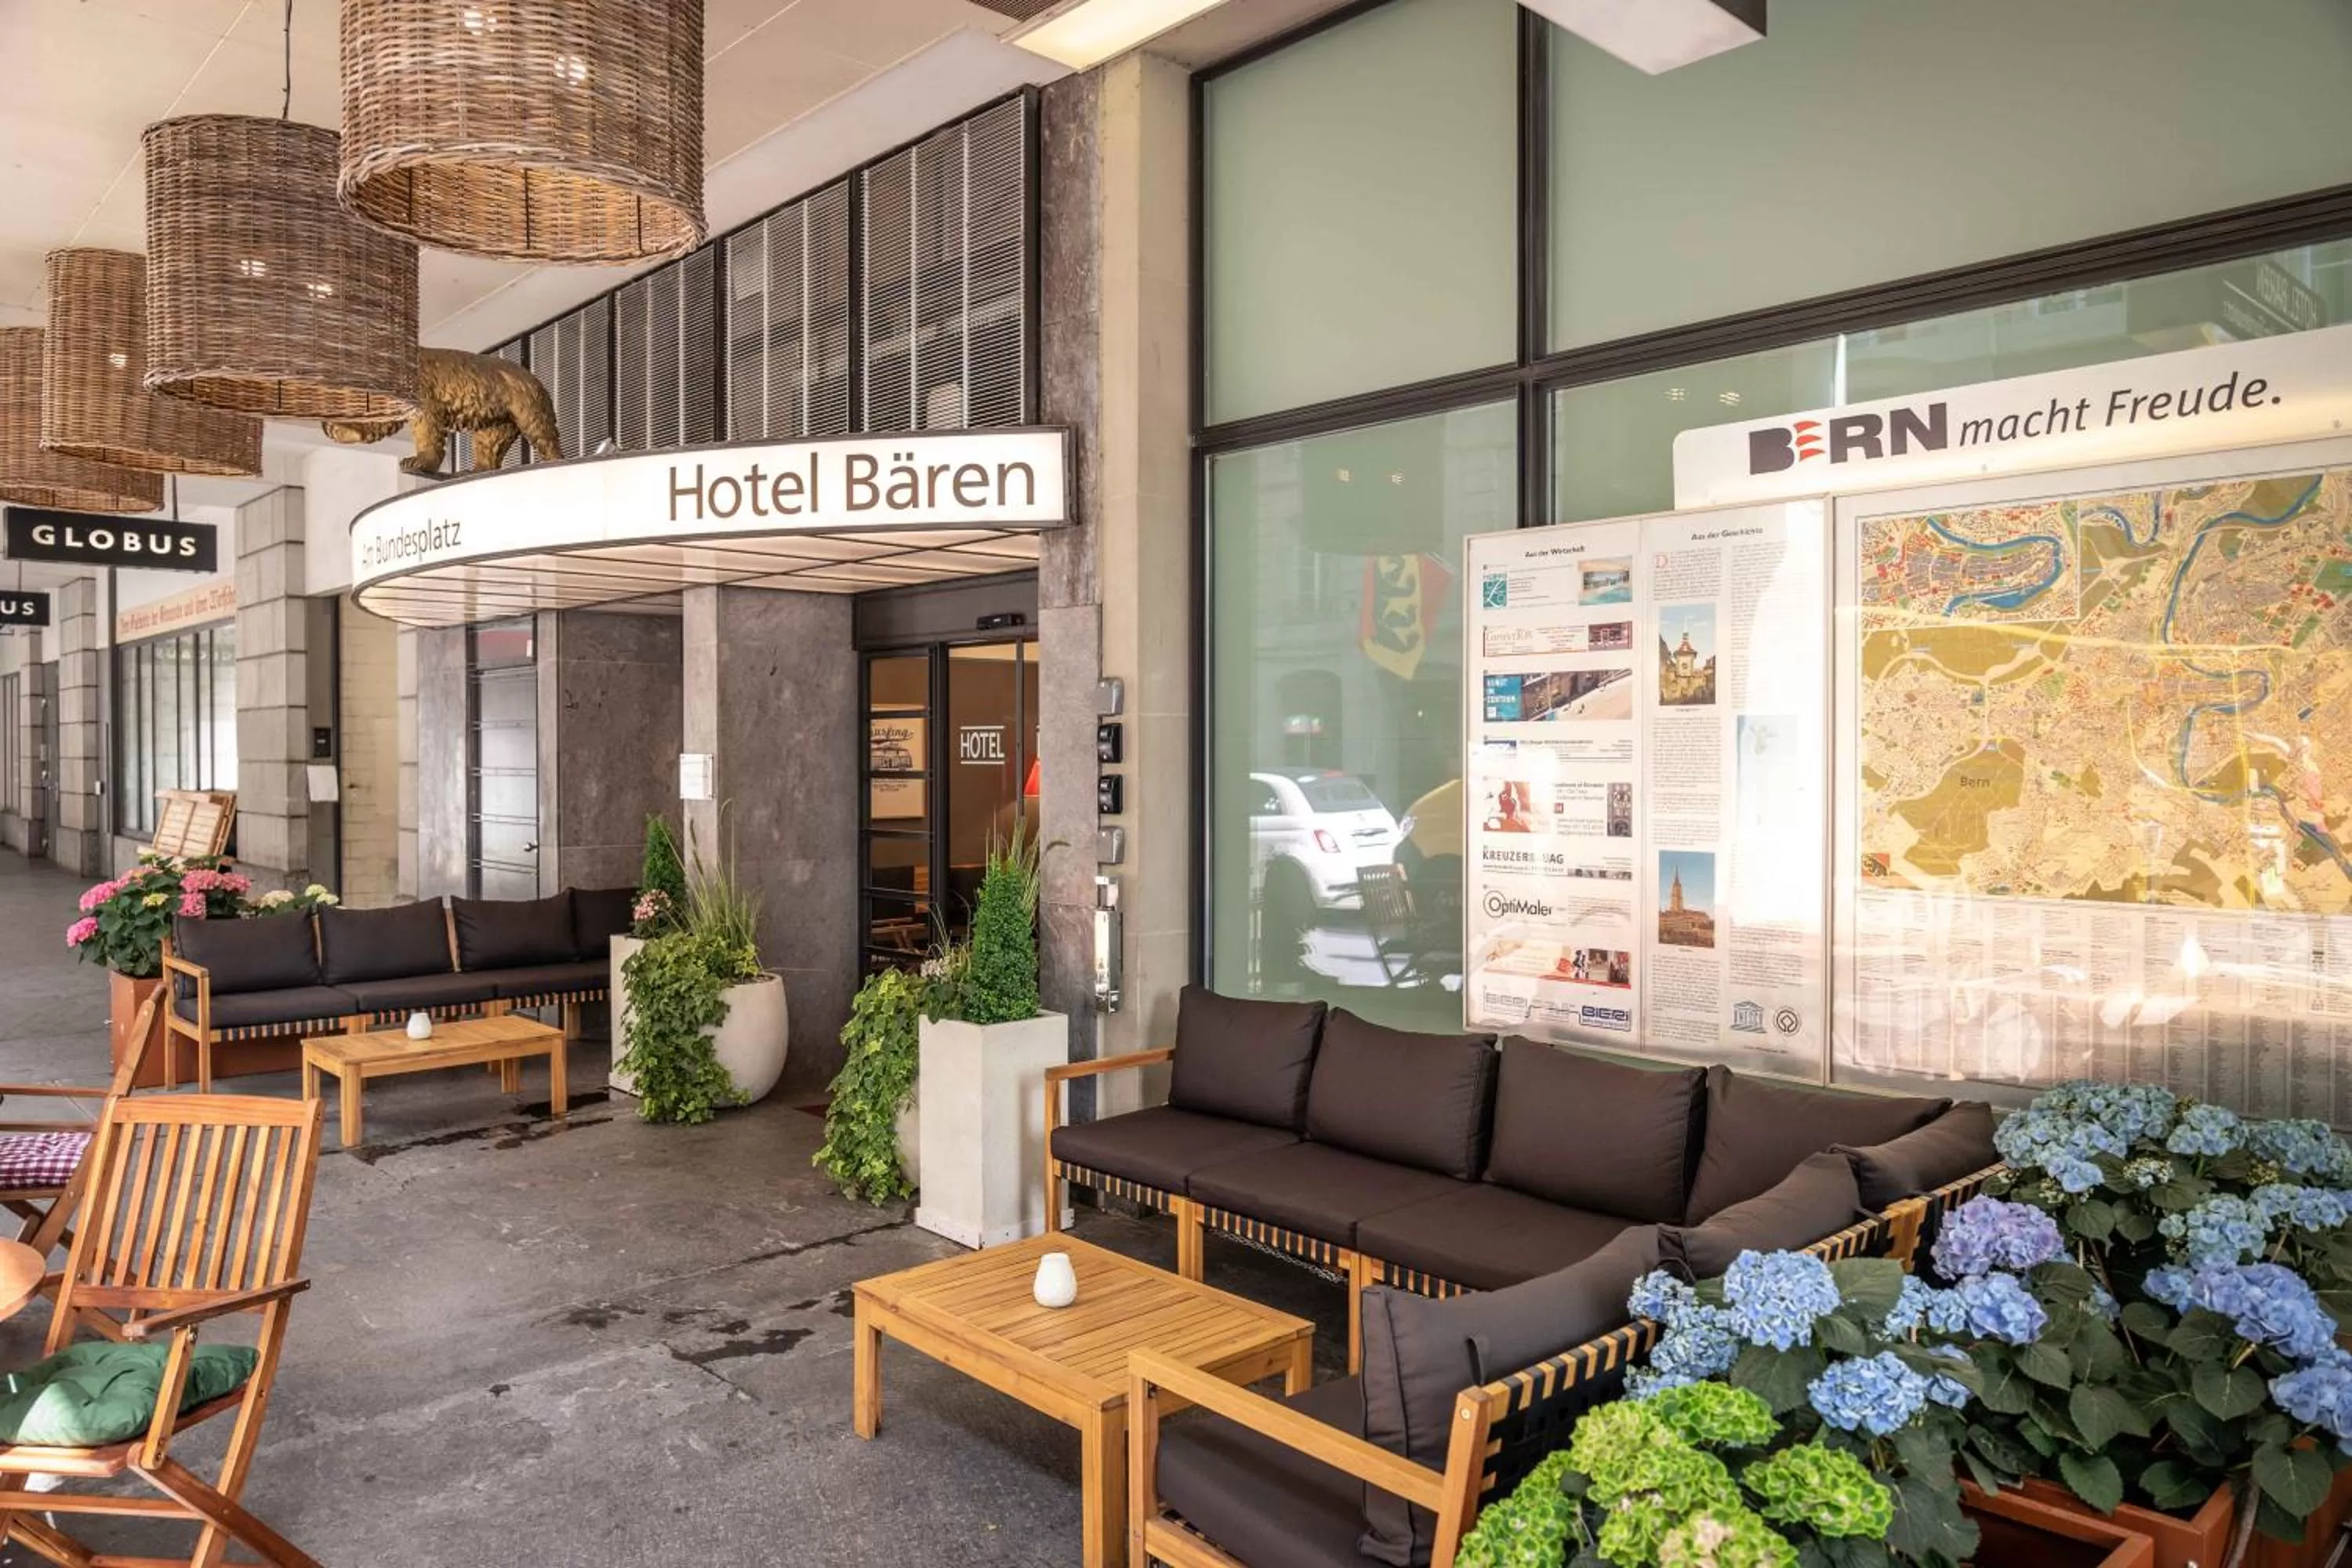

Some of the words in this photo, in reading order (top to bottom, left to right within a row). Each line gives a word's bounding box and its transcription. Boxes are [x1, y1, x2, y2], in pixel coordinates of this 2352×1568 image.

[1749, 402, 1947, 475] BERN
[1960, 399, 2091, 446] macht
[2105, 371, 2282, 428] Freude.
[670, 452, 818, 521] Hotel
[845, 452, 1035, 511] Bären
[31, 524, 196, 557] GLOBUS
[376, 517, 462, 564] Bundesplatz
[960, 731, 1004, 758] HOTEL
[1961, 775, 1991, 788] Bern
[1489, 896, 1553, 917] OptiMaler
